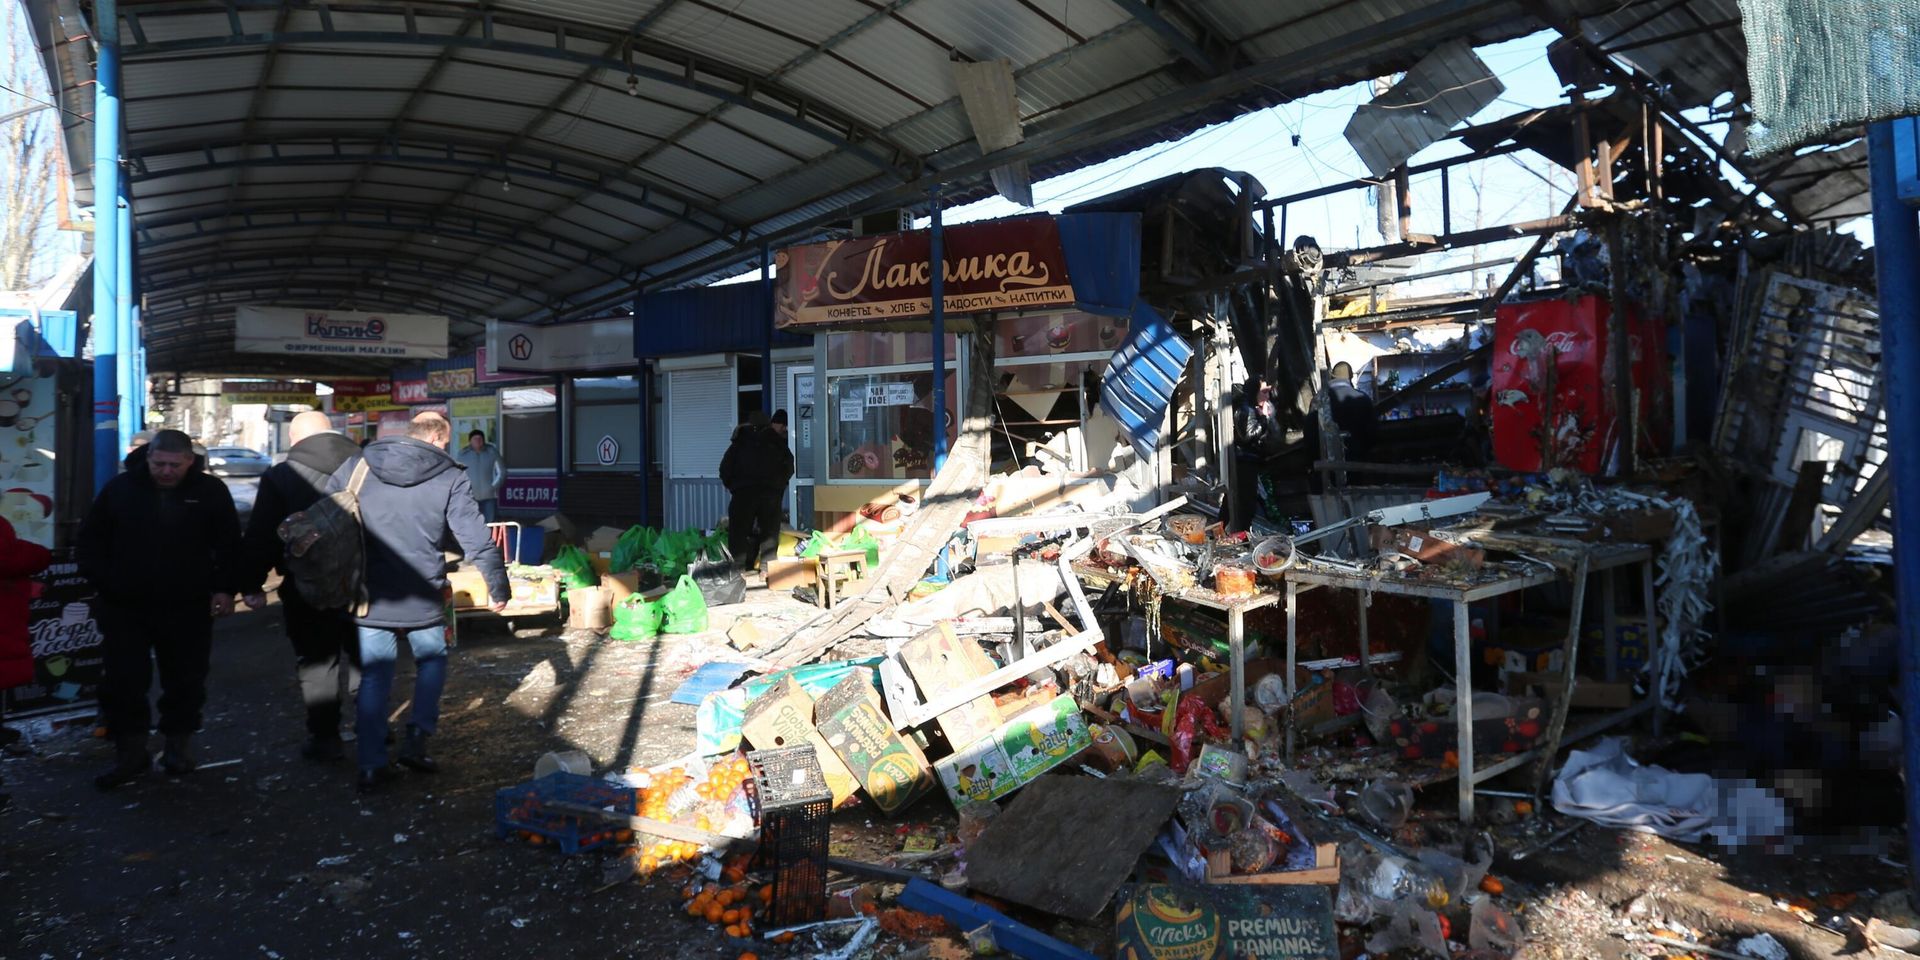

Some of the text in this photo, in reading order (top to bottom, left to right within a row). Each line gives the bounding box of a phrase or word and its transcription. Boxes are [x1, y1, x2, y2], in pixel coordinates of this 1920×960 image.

[828, 290, 1066, 318] КОНФЕТЫ ХЛЕБ ЛАДОСТИ НАПИТКИ
[285, 343, 406, 355] ФИРМЕННЫЙ МАГАЗИН
[241, 383, 300, 392] ЛОМБАРД
[399, 383, 428, 399] КУРС
[870, 387, 884, 395] ЧАЙ
[868, 396, 887, 405] КОФЕ
[801, 406, 811, 418] Z
[506, 488, 524, 500] ВСЕ
[526, 488, 550, 502] ДЛЯ
[772, 715, 798, 747] Villag
[781, 705, 813, 737] Global
[851, 706, 890, 750] BANANAS
[843, 716, 881, 759] PREMIUM
[1039, 729, 1070, 757] patty
[967, 776, 993, 799] patty
[1150, 923, 1208, 945] Vicky
[1228, 918, 1320, 937] PREMIUM
[1154, 940, 1216, 957] BANANAS
[1233, 936, 1326, 957] BANANAS
